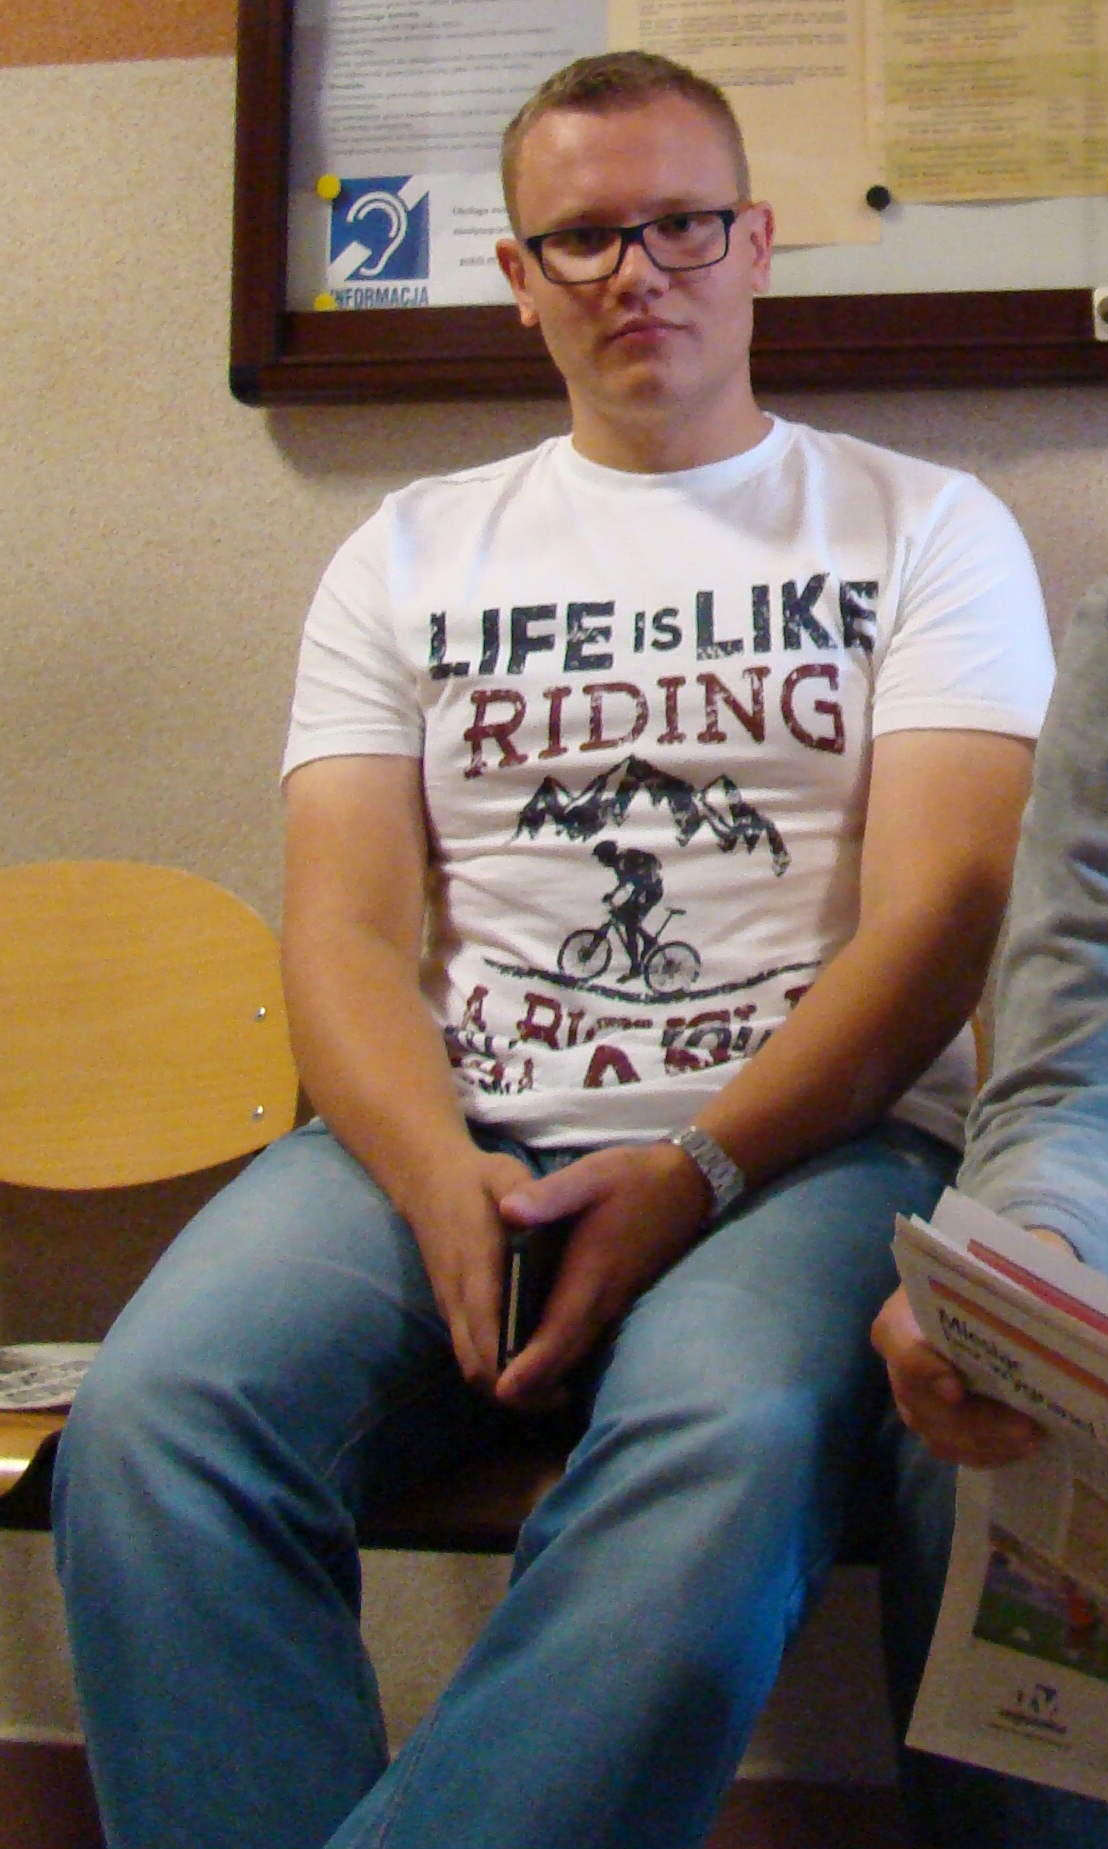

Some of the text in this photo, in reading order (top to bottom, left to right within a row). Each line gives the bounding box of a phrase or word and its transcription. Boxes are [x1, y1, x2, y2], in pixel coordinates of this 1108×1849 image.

[430, 572, 879, 679] LIFE IS LIKE
[464, 663, 846, 779] RIDING
